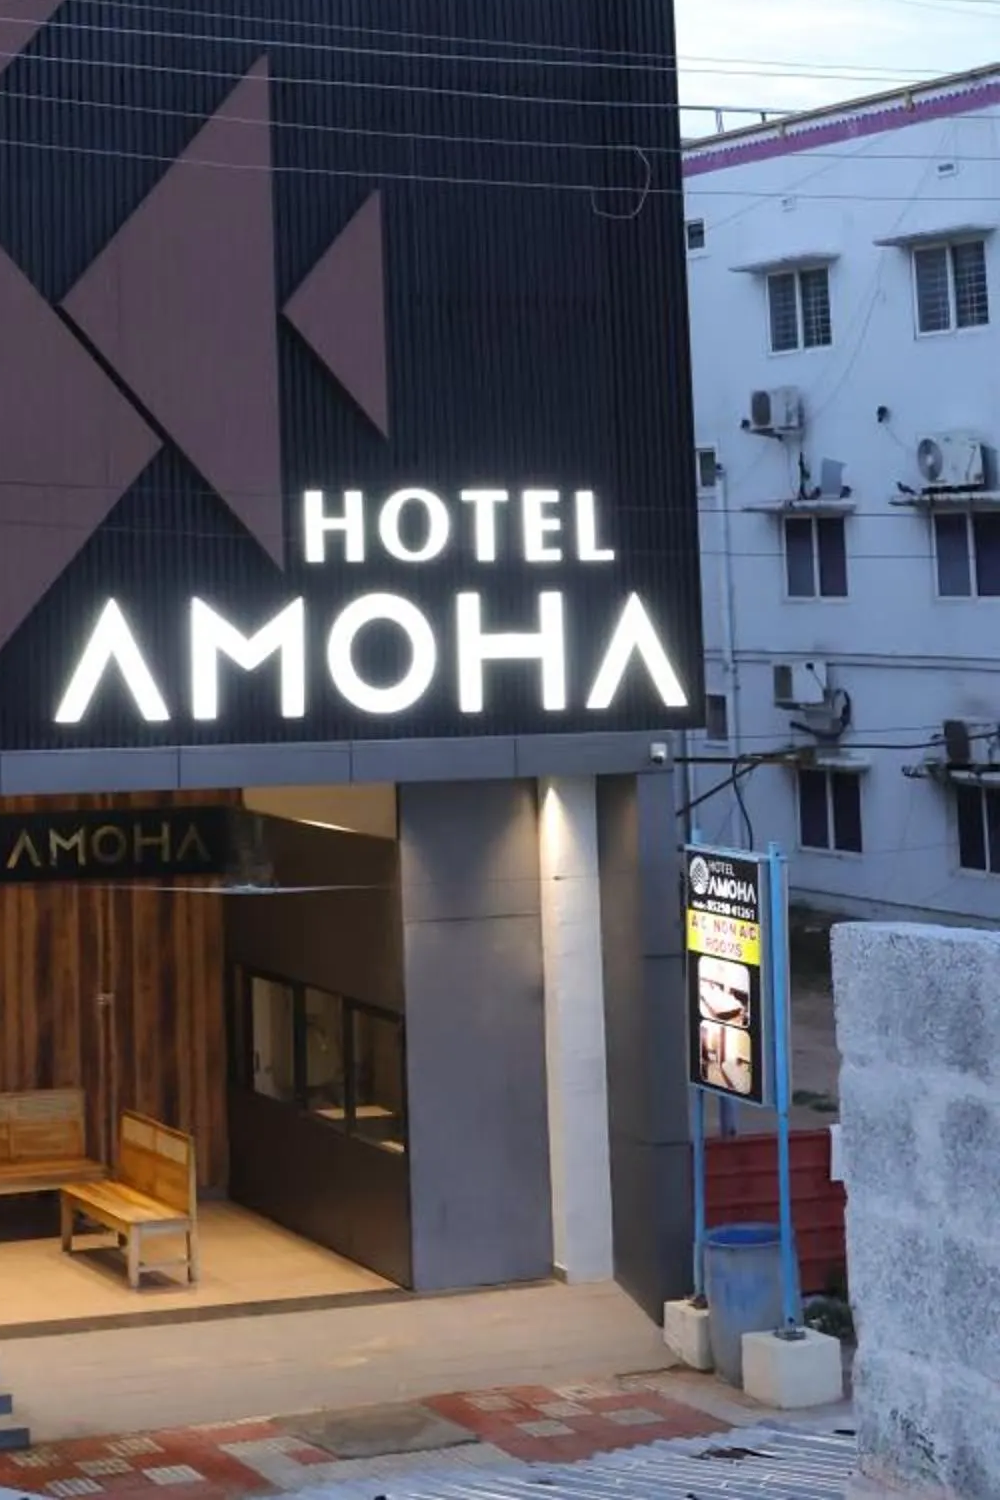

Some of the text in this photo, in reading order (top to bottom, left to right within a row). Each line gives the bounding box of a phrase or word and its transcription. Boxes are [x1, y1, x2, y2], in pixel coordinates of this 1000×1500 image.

[303, 488, 616, 564] HOTEL
[54, 590, 689, 724] AMOHA
[6, 821, 212, 869] AMOHA
[708, 860, 735, 877] HOTEL
[708, 876, 757, 904] AMOHA
